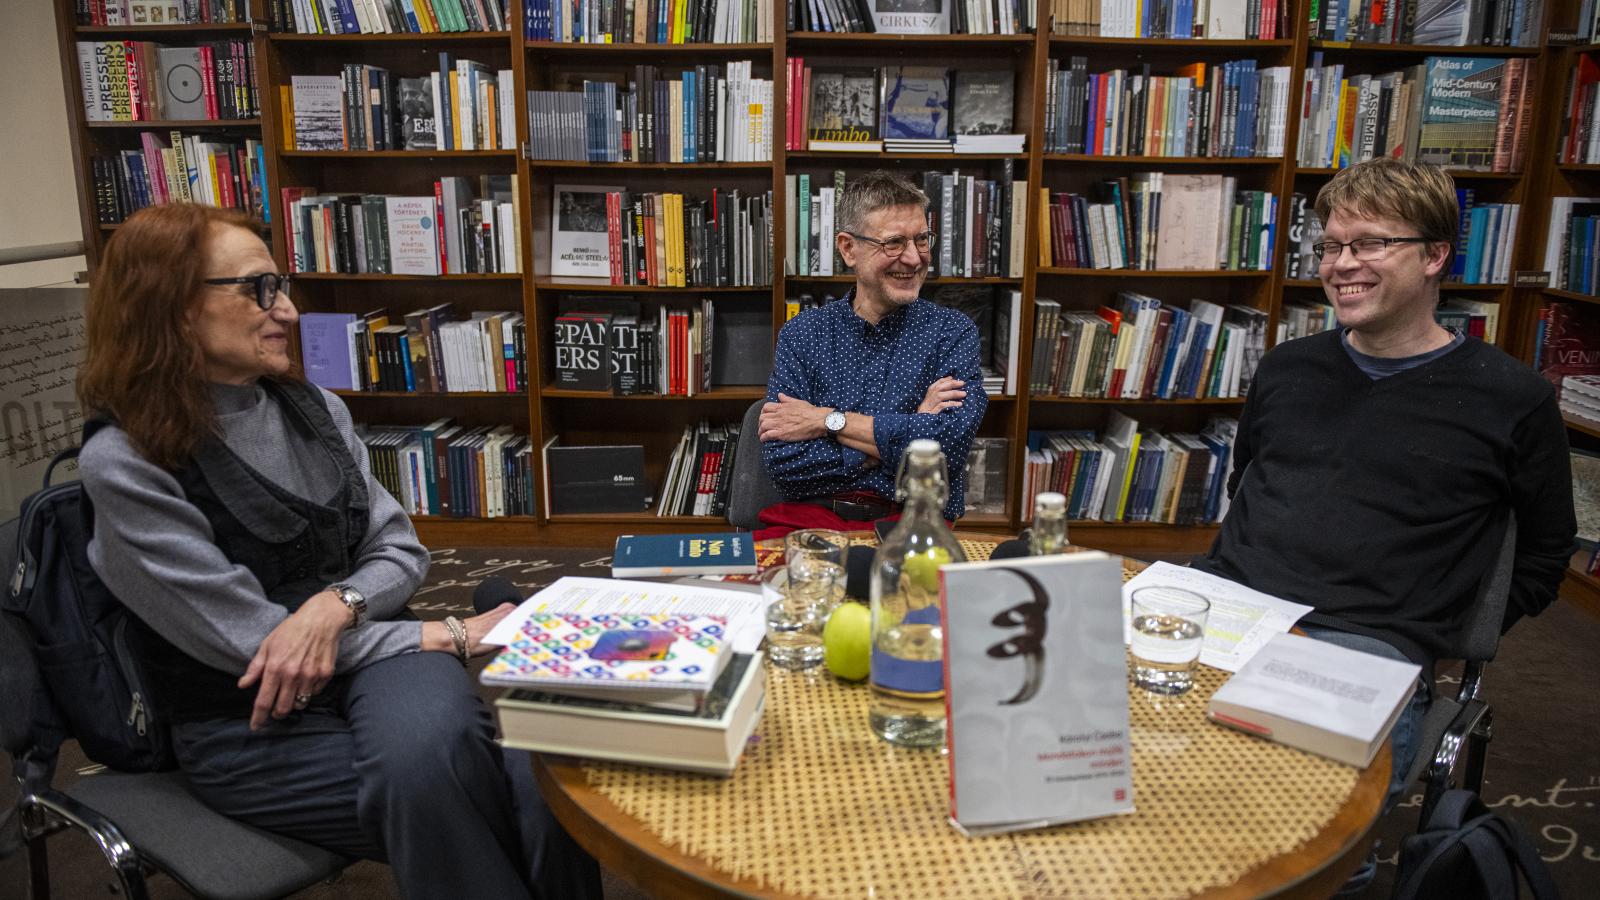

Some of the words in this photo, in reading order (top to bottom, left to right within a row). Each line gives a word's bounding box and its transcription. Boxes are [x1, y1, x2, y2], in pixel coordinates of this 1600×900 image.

[880, 15, 939, 28] CIRKUSZ
[217, 60, 225, 82] SLASH
[226, 60, 234, 82] SLASH
[1434, 60, 1460, 70] Atlas
[1462, 60, 1474, 70] of
[83, 61, 95, 110] Madonna
[96, 47, 113, 111] PRESSER
[107, 60, 121, 115] PRESSER
[116, 61, 131, 115] PRESSER
[1432, 78, 1496, 91] Mid-Century
[1358, 79, 1370, 114] WOHA
[1431, 88, 1471, 98] Modern
[1429, 106, 1496, 118] Masterpieces
[813, 126, 870, 141] Limbo
[1362, 93, 1379, 158] ASSEMBLE
[178, 174, 190, 200] ELEVATORS
[943, 187, 952, 208] IT'S
[943, 210, 952, 230] ALL
[943, 231, 953, 258] TRUE
[556, 346, 600, 370] ERS
[613, 474, 635, 482] 65mm
[708, 540, 724, 556] Non
